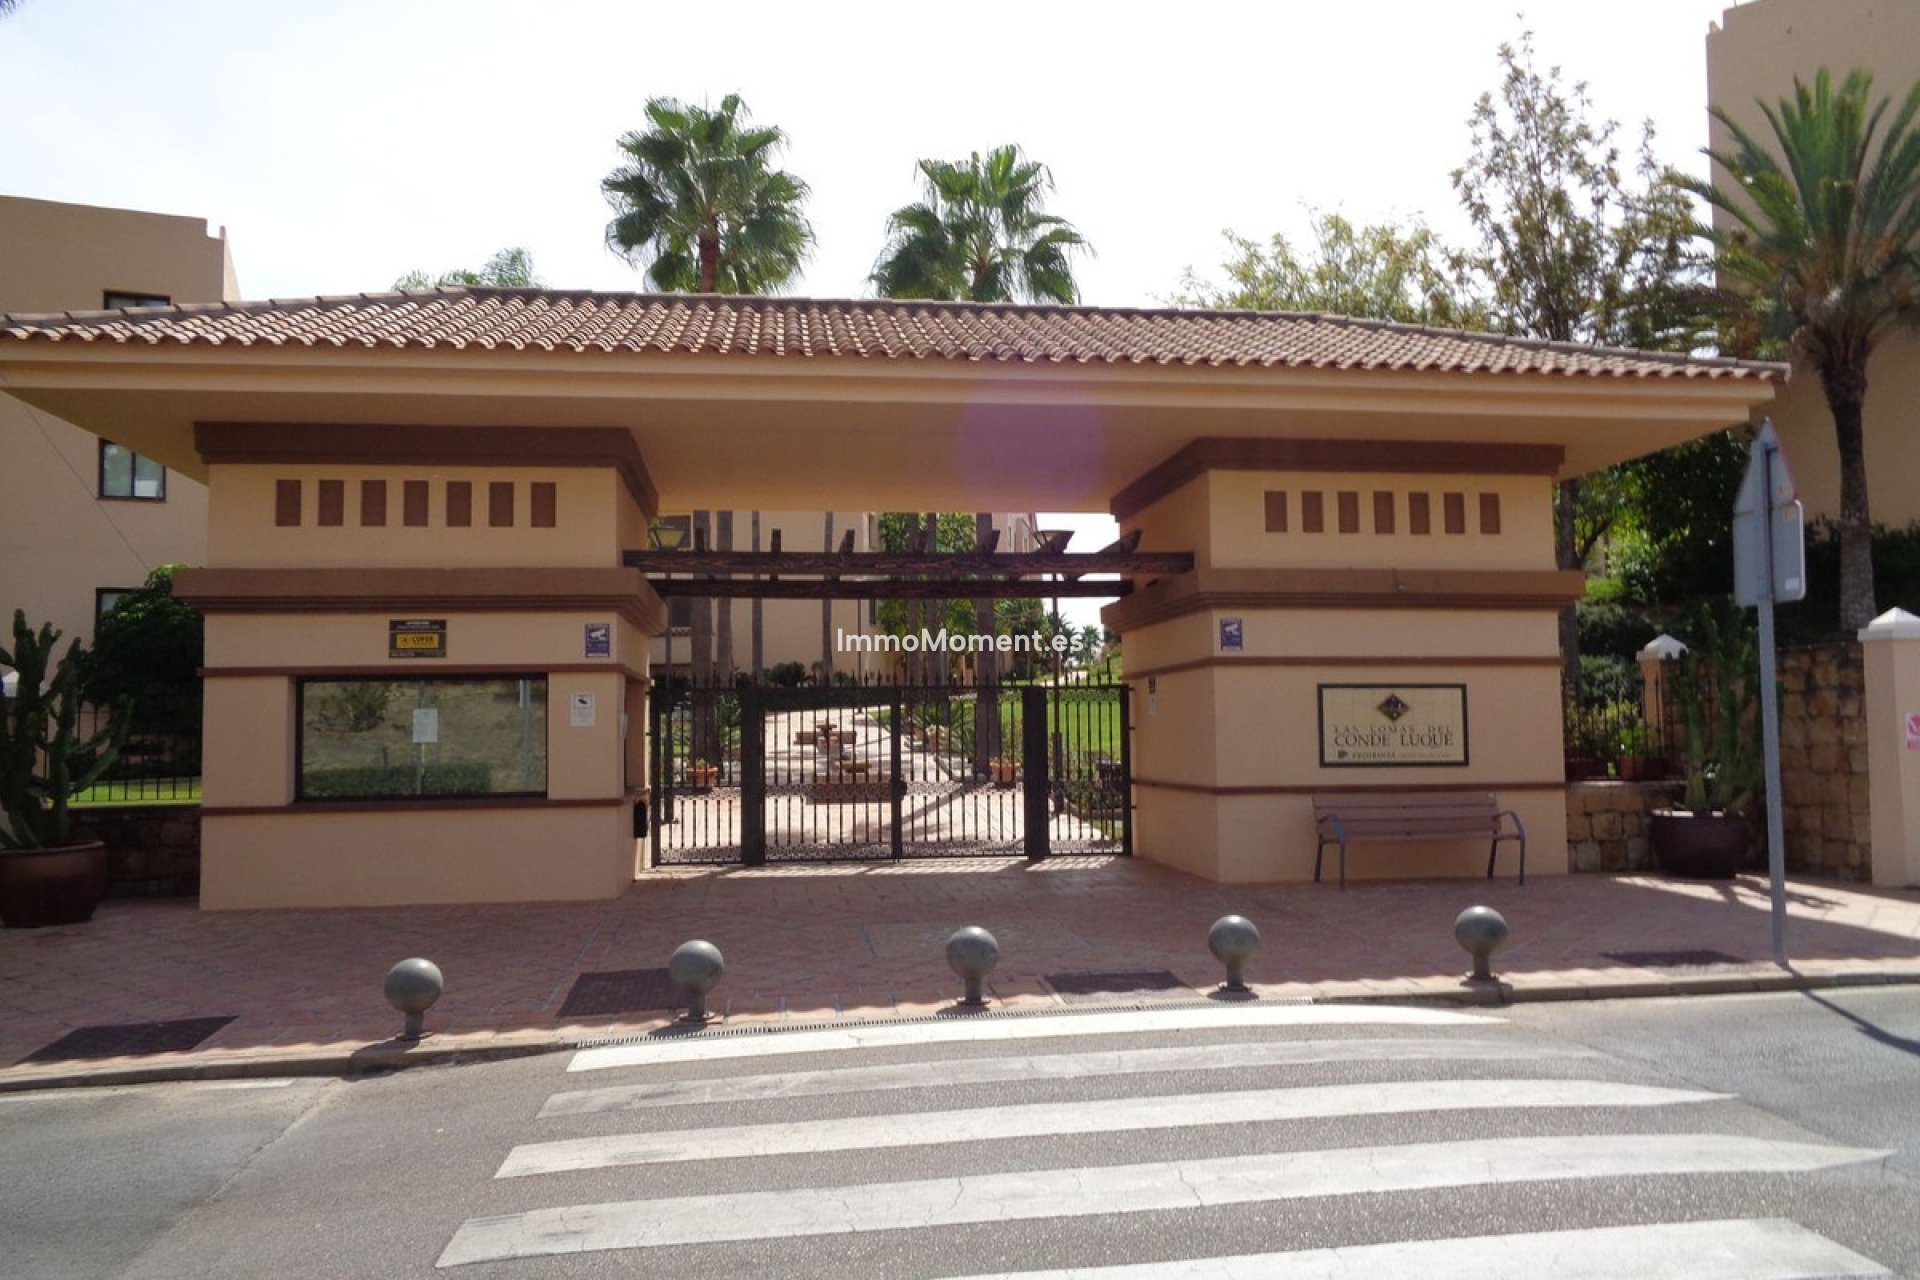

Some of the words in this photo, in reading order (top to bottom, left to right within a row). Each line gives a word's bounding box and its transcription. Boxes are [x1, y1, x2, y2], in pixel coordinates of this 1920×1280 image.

[1333, 725, 1360, 736] LAS
[1369, 725, 1415, 736] LOMAS
[1428, 725, 1454, 736] DEL
[1333, 734, 1389, 747] CONDE
[1400, 734, 1454, 749] LUQUE
